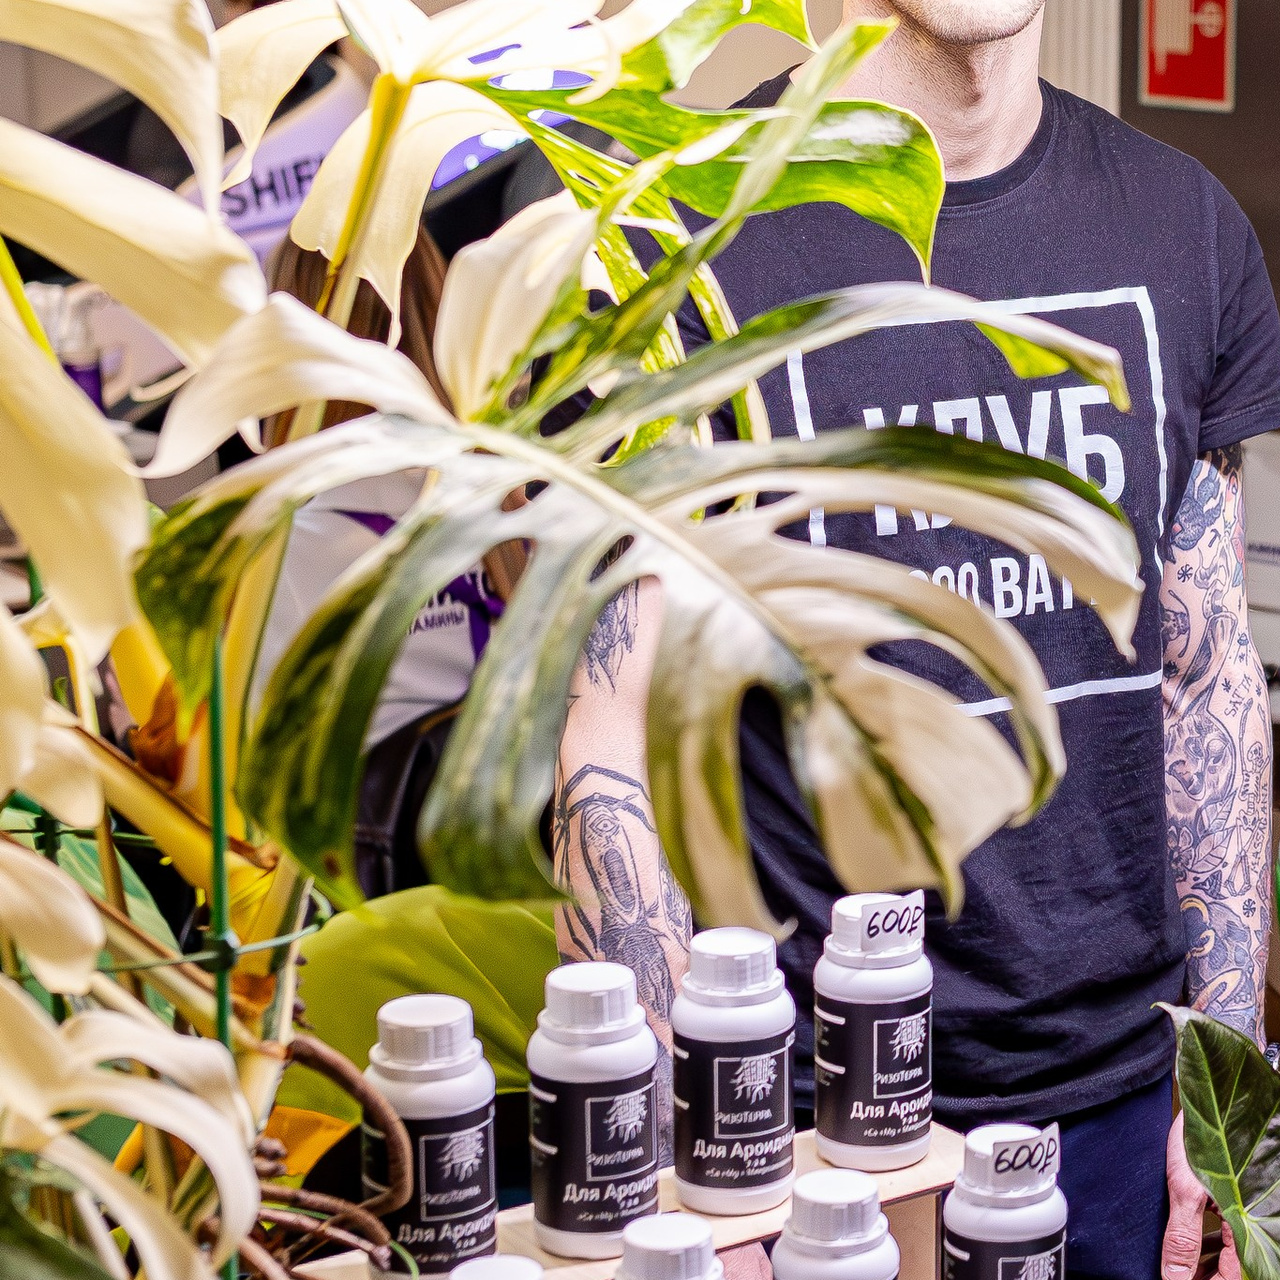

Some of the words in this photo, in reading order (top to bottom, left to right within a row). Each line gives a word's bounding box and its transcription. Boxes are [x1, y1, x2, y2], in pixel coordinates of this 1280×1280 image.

[1224, 673, 1253, 718] SATTA
[850, 1101, 885, 1121] Для
[693, 1138, 727, 1159] Для
[562, 1182, 601, 1205] Для
[396, 1223, 436, 1245] Для
